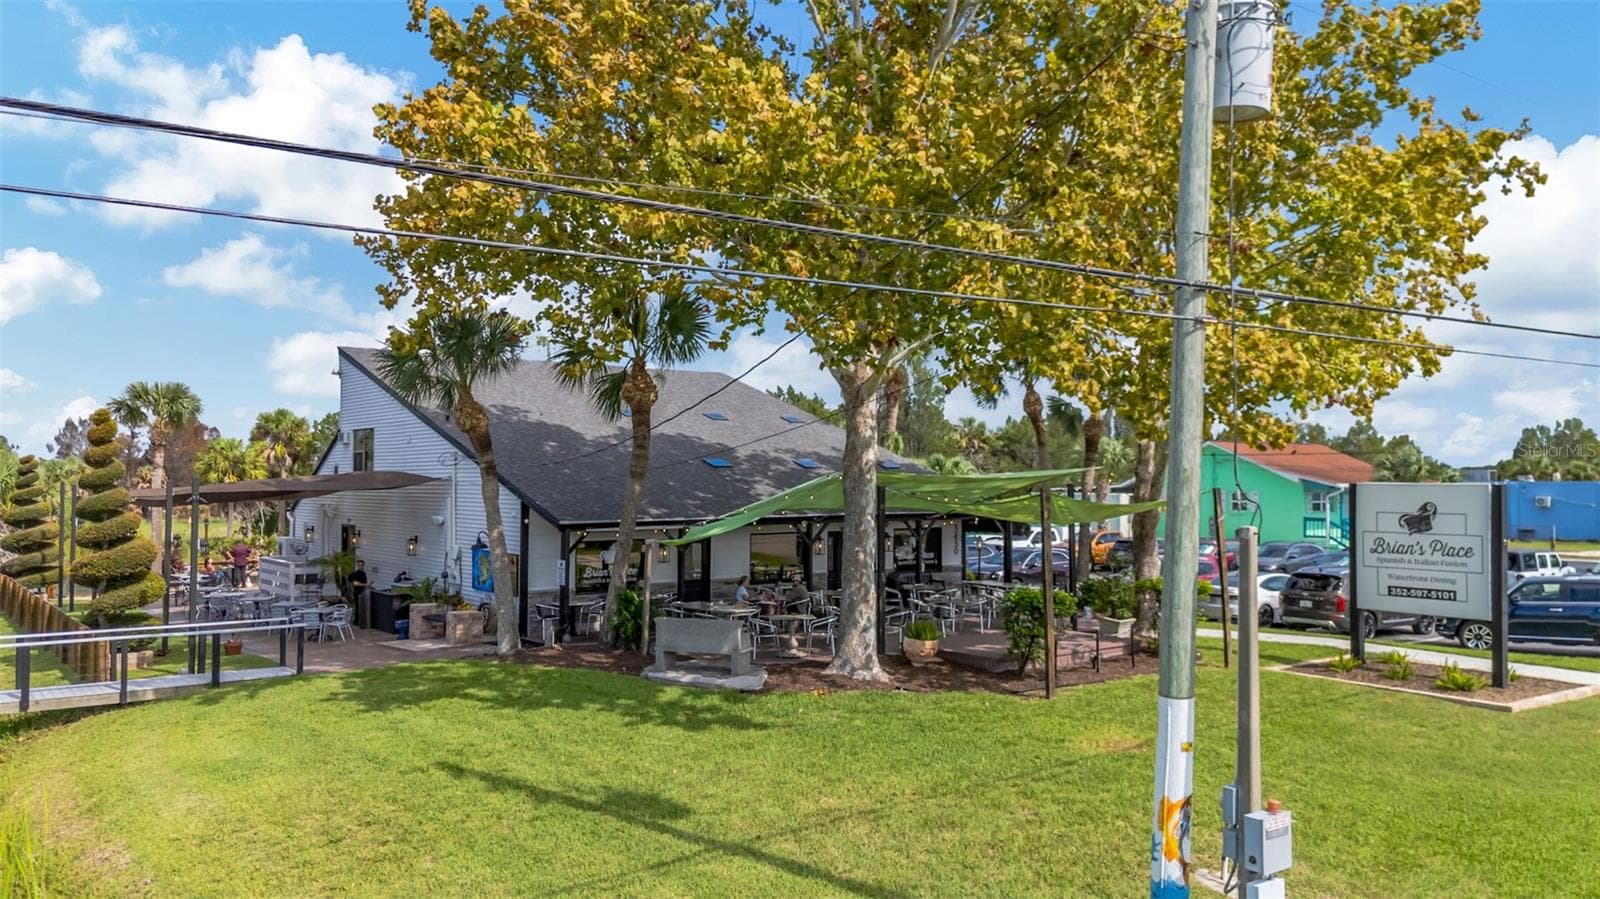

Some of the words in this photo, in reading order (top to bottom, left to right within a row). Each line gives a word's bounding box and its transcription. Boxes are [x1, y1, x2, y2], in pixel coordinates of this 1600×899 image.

[1369, 537, 1427, 557] Brian's
[1429, 539, 1475, 559] Place
[1376, 556, 1406, 565] Spanish
[1414, 558, 1440, 567] Italian
[1441, 560, 1468, 568] Fusion
[1387, 573, 1429, 582] Waterfront
[1430, 576, 1457, 585] Dining
[1389, 587, 1455, 600] 352-597-5101
